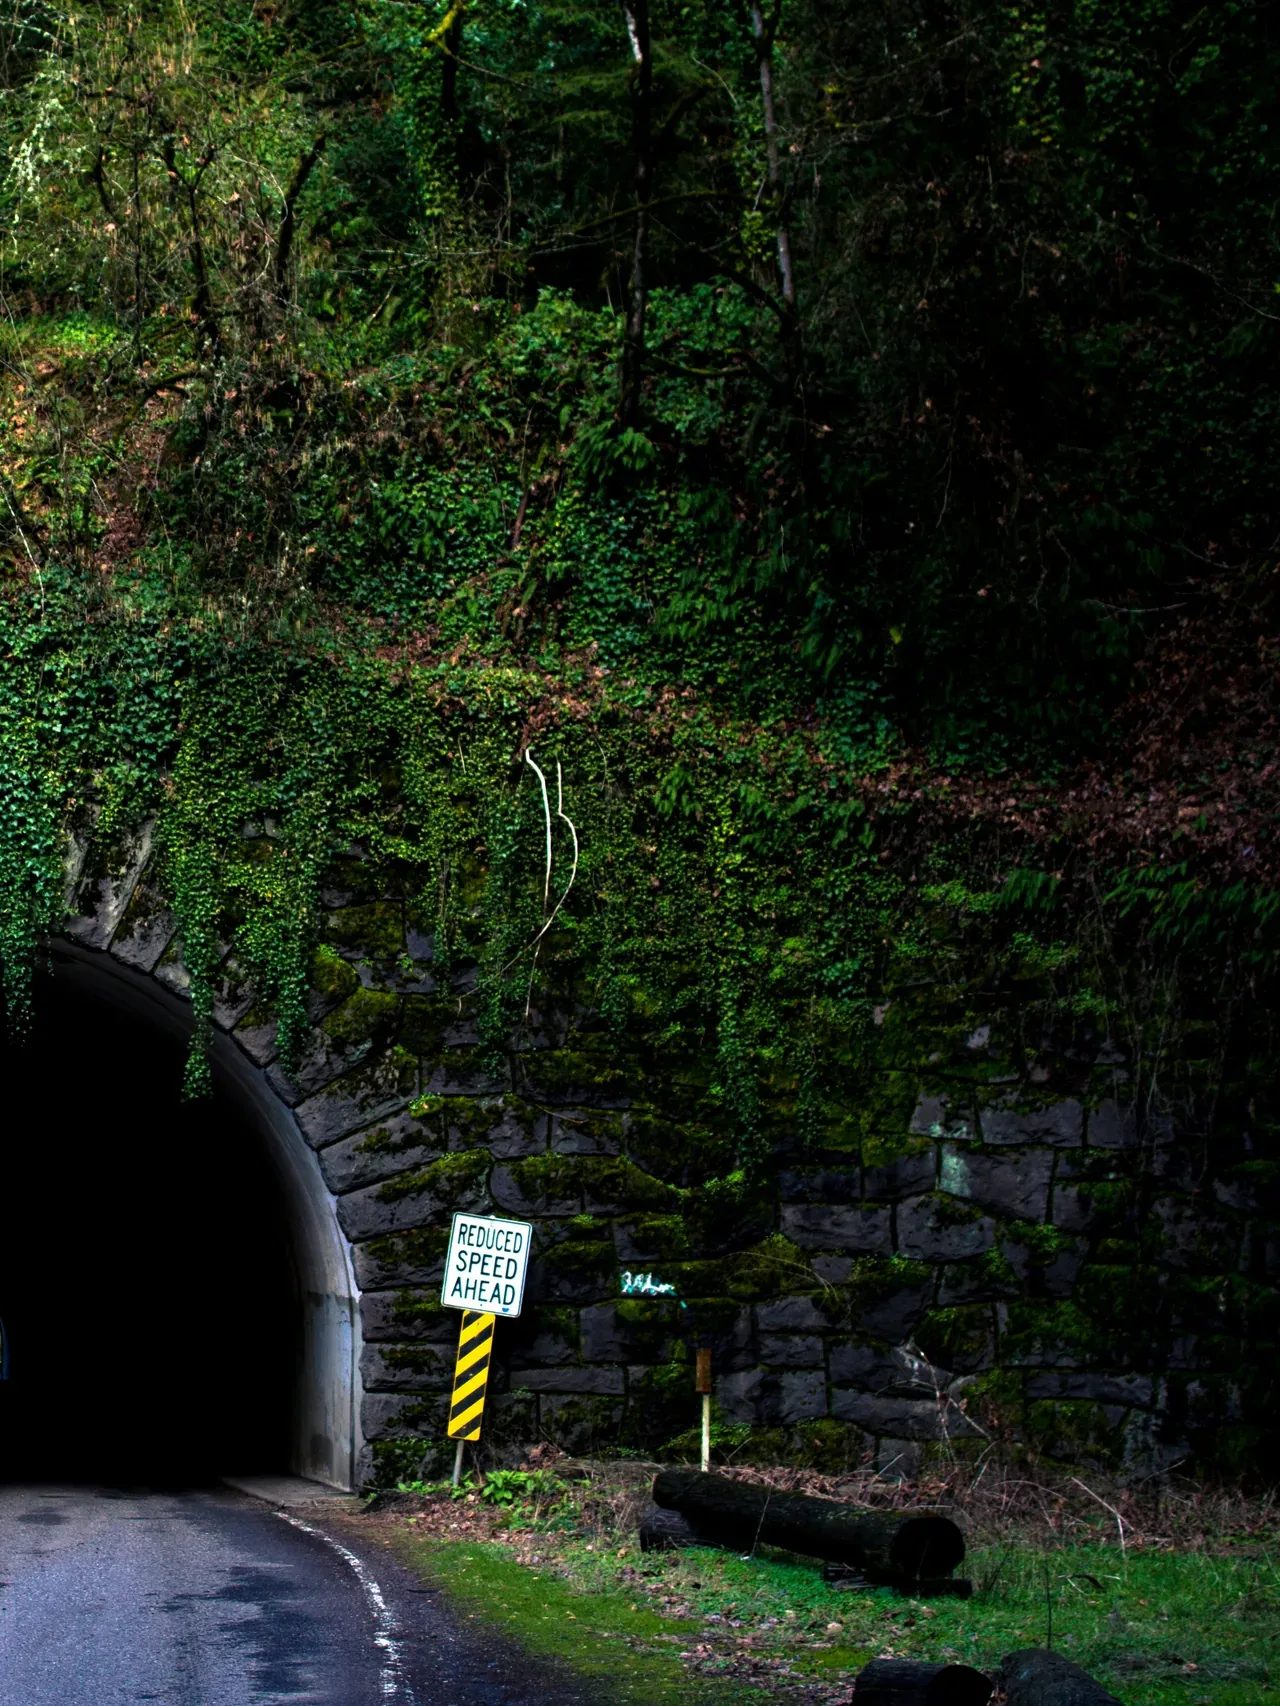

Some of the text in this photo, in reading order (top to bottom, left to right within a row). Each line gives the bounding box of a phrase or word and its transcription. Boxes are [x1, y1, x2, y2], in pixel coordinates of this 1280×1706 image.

[457, 1223, 523, 1254] REDUCED
[455, 1250, 518, 1280] SPEED
[450, 1276, 516, 1306] AHEAD
